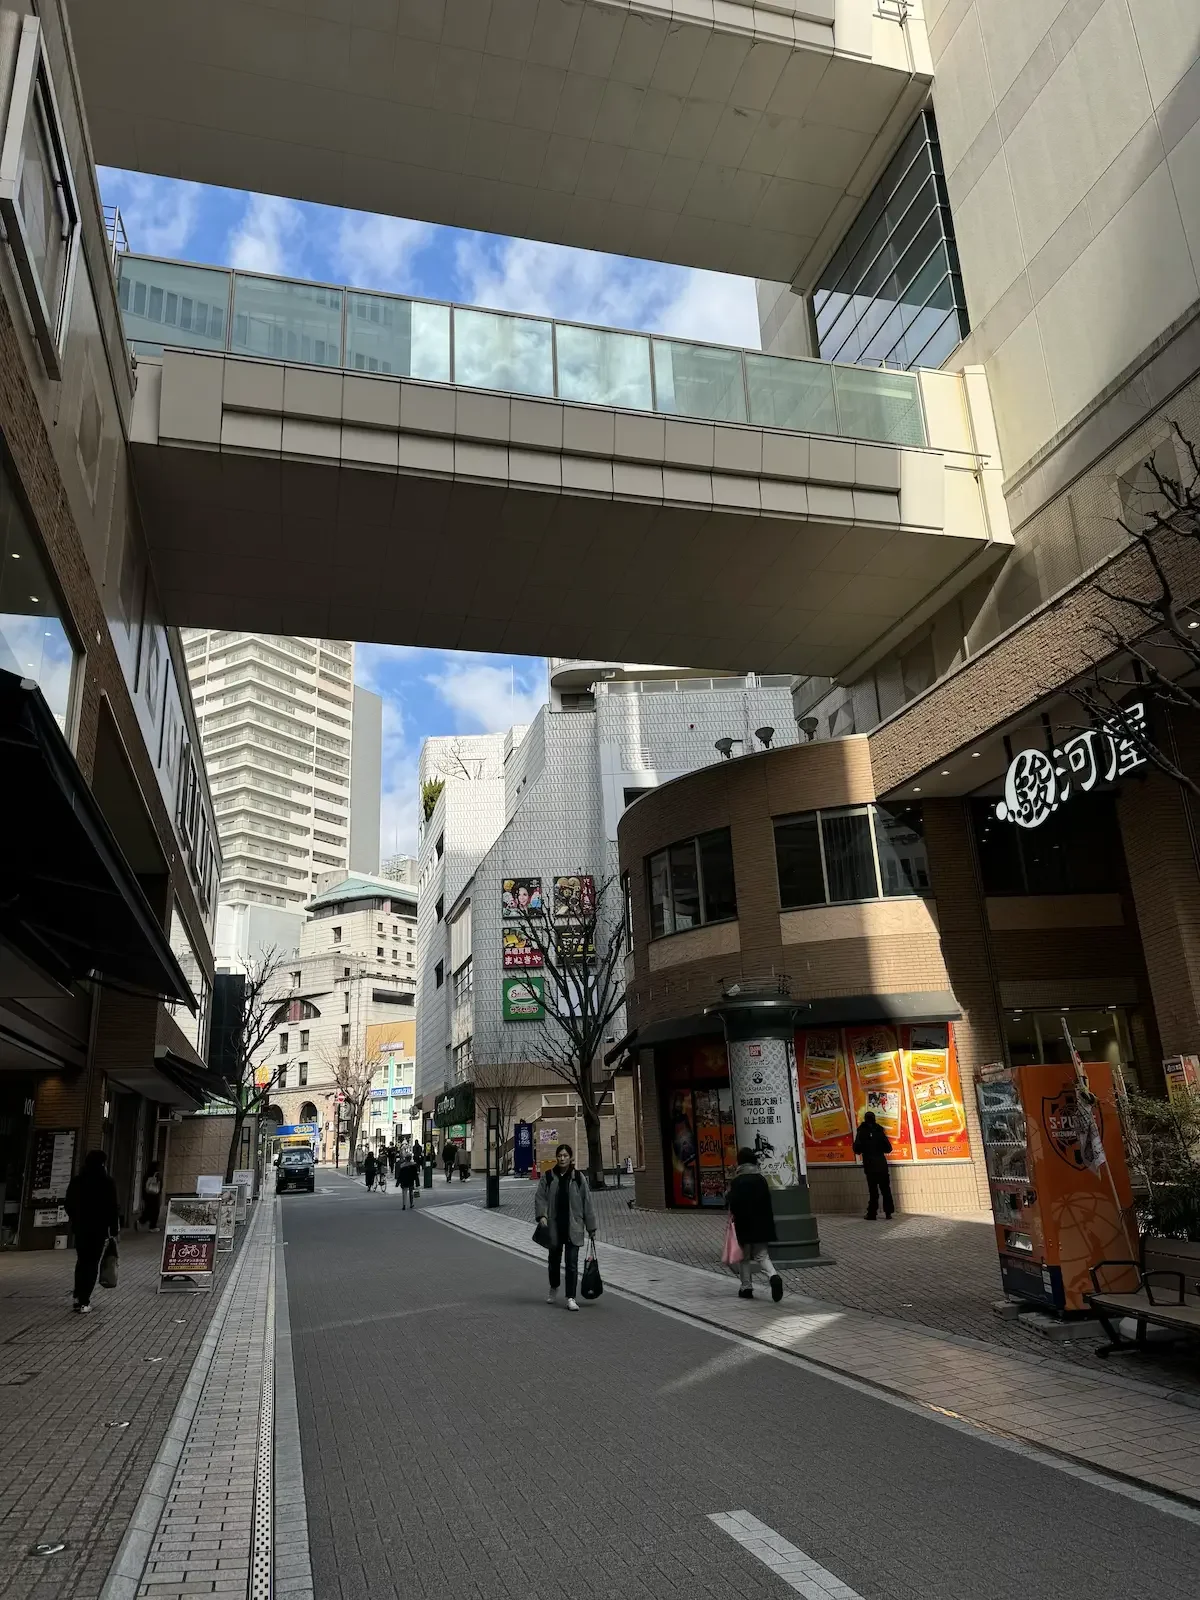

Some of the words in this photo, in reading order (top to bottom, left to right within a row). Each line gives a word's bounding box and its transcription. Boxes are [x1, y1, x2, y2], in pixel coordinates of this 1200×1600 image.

[504, 956, 542, 966] まねきや
[747, 1107, 765, 1115] 700
